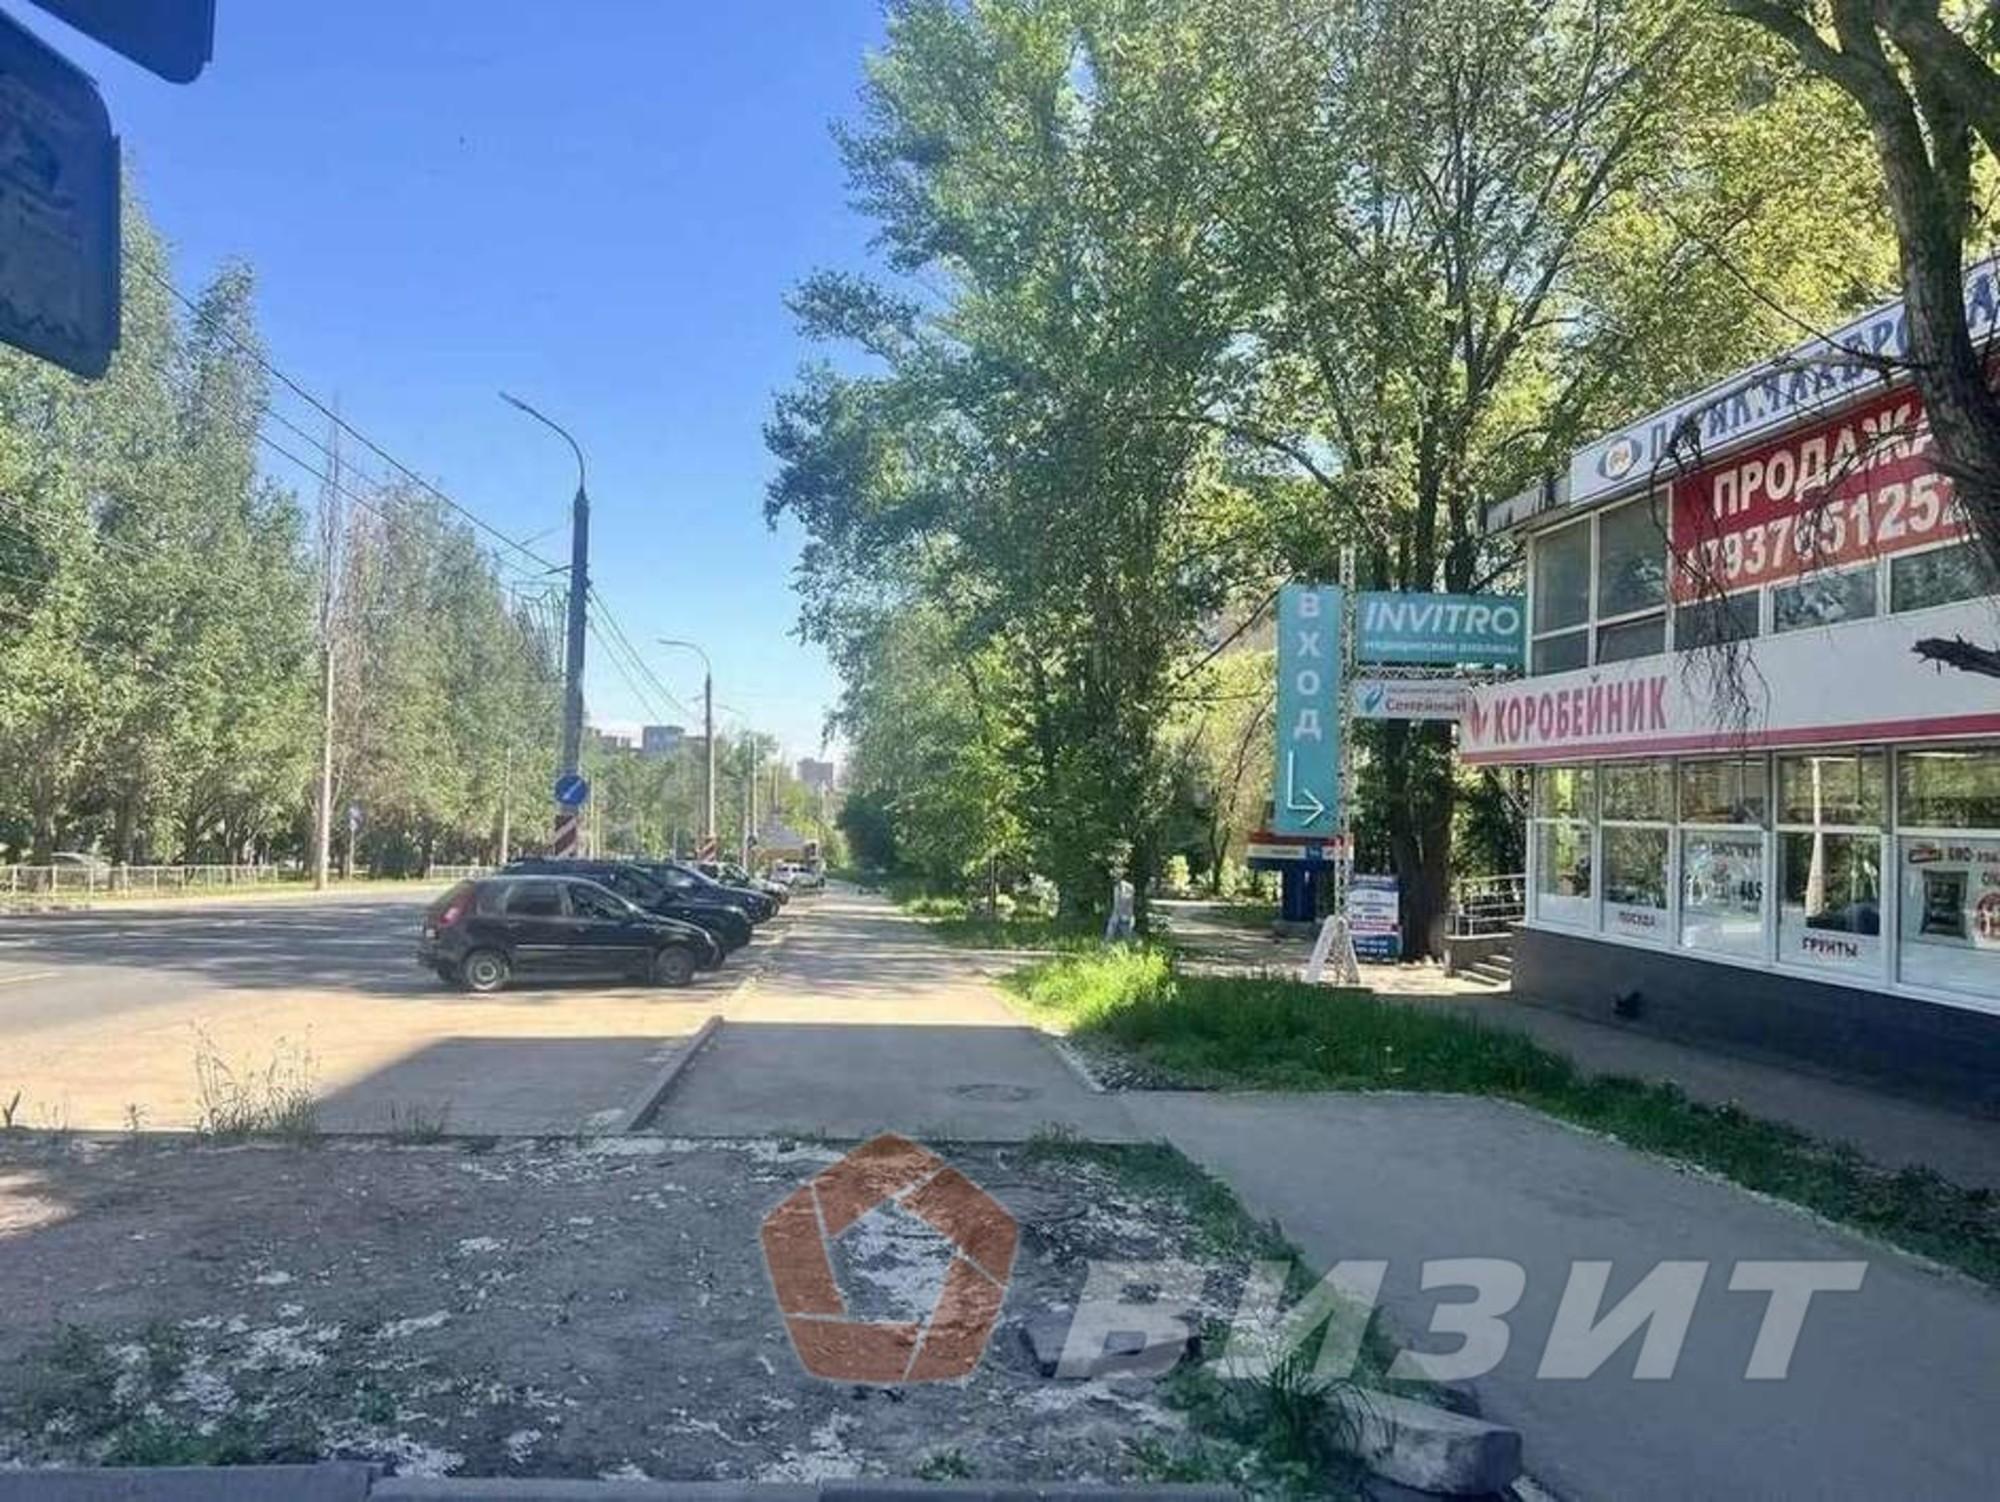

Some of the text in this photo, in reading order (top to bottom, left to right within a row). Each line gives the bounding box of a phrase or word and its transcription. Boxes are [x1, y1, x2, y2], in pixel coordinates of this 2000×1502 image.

[1364, 602, 1520, 636] INVITRO
[1293, 592, 1323, 742] ВХОД
[1494, 674, 1668, 745] КОРОБЕЙНИК
[1802, 937, 1858, 958] ГРУНТЫ
